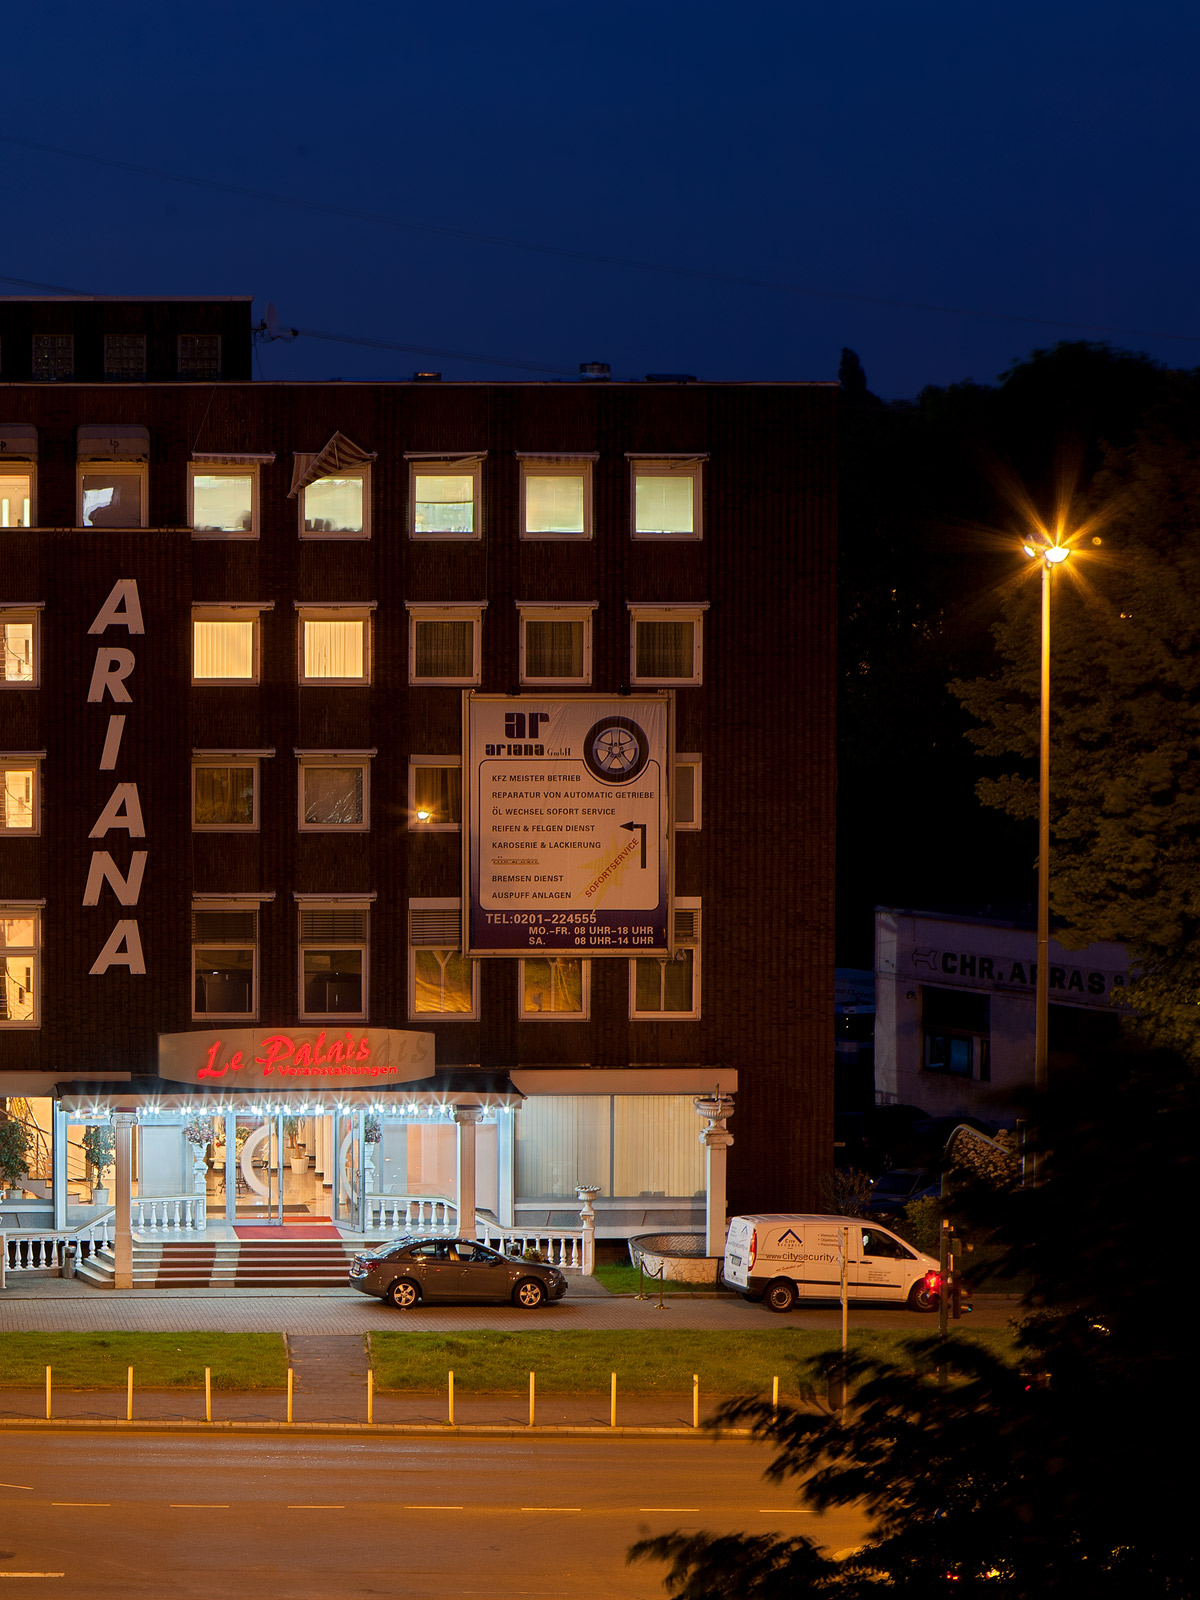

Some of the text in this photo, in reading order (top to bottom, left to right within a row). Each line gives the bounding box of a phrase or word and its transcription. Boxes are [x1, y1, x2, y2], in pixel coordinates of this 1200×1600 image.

[505, 712, 550, 739] ar
[485, 744, 571, 756] ariana GmbH
[82, 579, 148, 975] ARIANA
[492, 774, 581, 782] KFZ MEISTER BETRIEB
[492, 791, 655, 799] REPARATUR VON AUTOMATIC GETRIEBE
[492, 806, 503, 815] ÖL
[492, 841, 601, 849] KAROSERIE & LACKIERUNG
[585, 838, 640, 898] SOFORTSERVICE
[492, 891, 572, 899] AUSPUFF ANLAGEN
[485, 913, 597, 924] TEL:0201-224555
[529, 926, 654, 935] MO.-FR. 08 UHR-18 UHR
[529, 936, 654, 945] SA. 08 UHR-14 UHR
[942, 952, 1004, 981] CHR.
[197, 1040, 244, 1079] Le
[256, 1030, 371, 1076] Palais
[278, 1064, 398, 1077] Veranstaltungen
